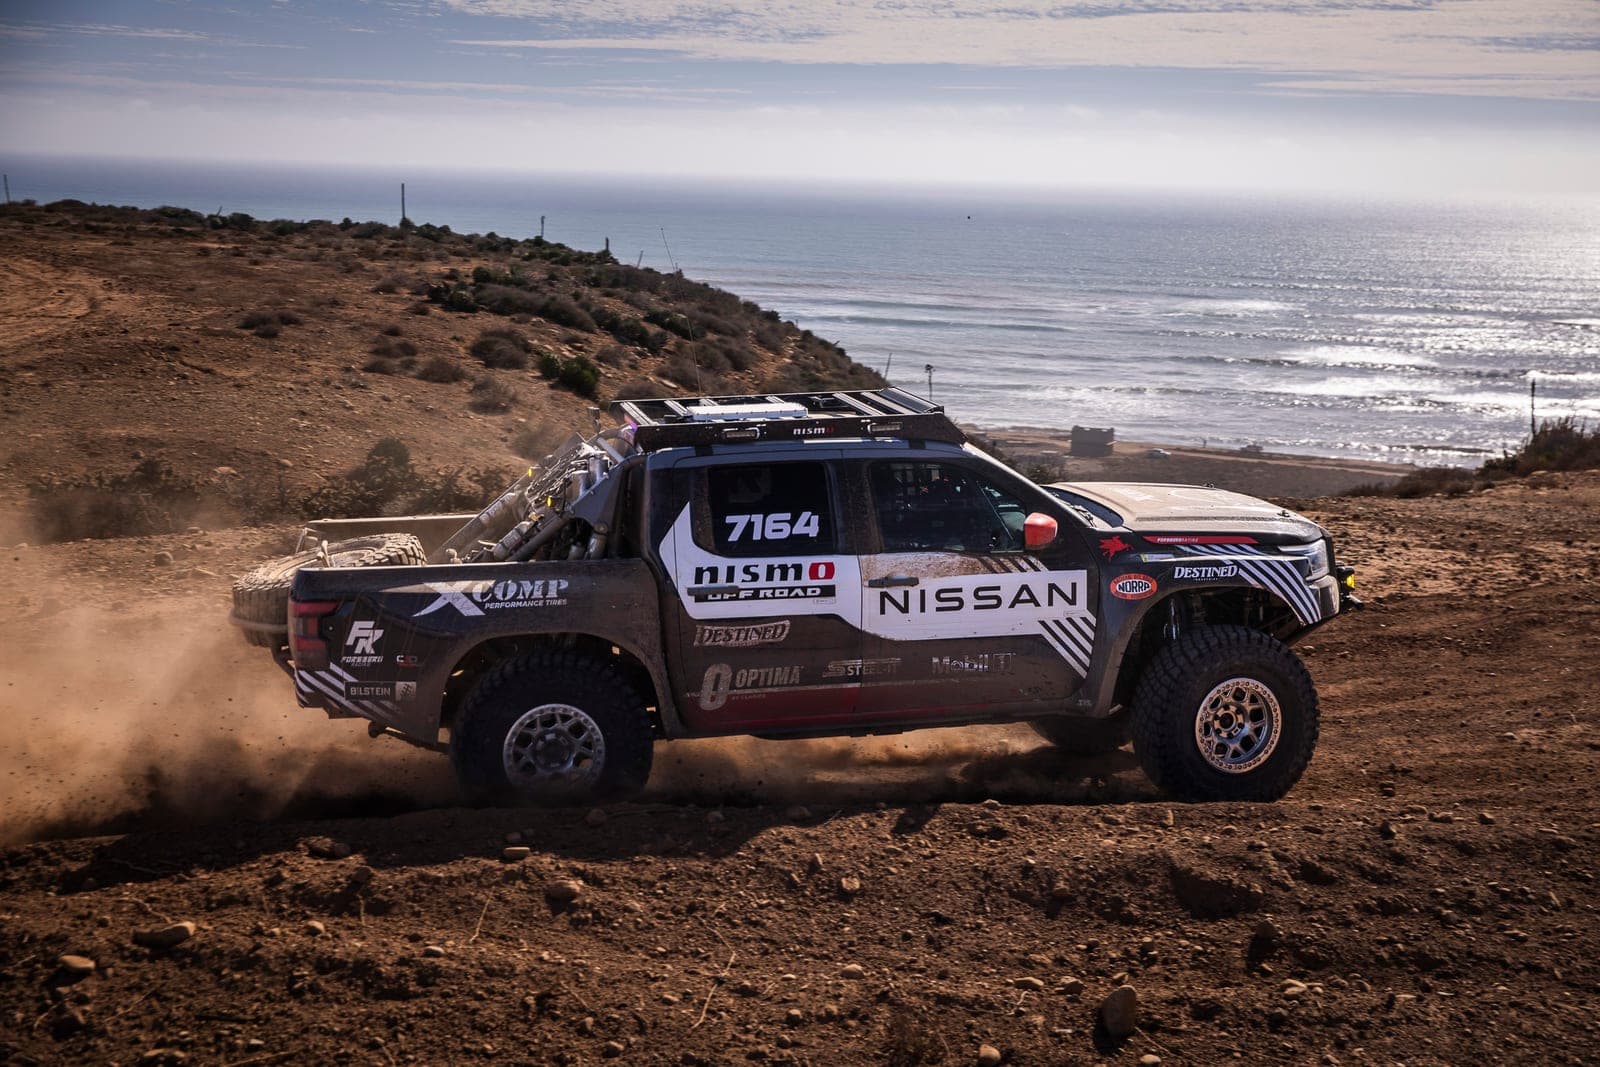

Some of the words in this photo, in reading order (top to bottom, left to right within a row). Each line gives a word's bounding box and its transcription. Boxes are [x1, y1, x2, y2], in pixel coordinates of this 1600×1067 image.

[725, 511, 820, 542] 7164
[694, 562, 835, 585] nismo
[1173, 565, 1239, 579] DESTINED
[759, 587, 822, 598] ROAD
[879, 582, 1077, 615] NISSAN
[484, 600, 544, 610] PERFORMANCE
[546, 598, 568, 606] TIRES
[700, 623, 787, 643] DESTINED
[735, 665, 801, 688] OPTIMA
[350, 687, 391, 696] BILSTEIN
